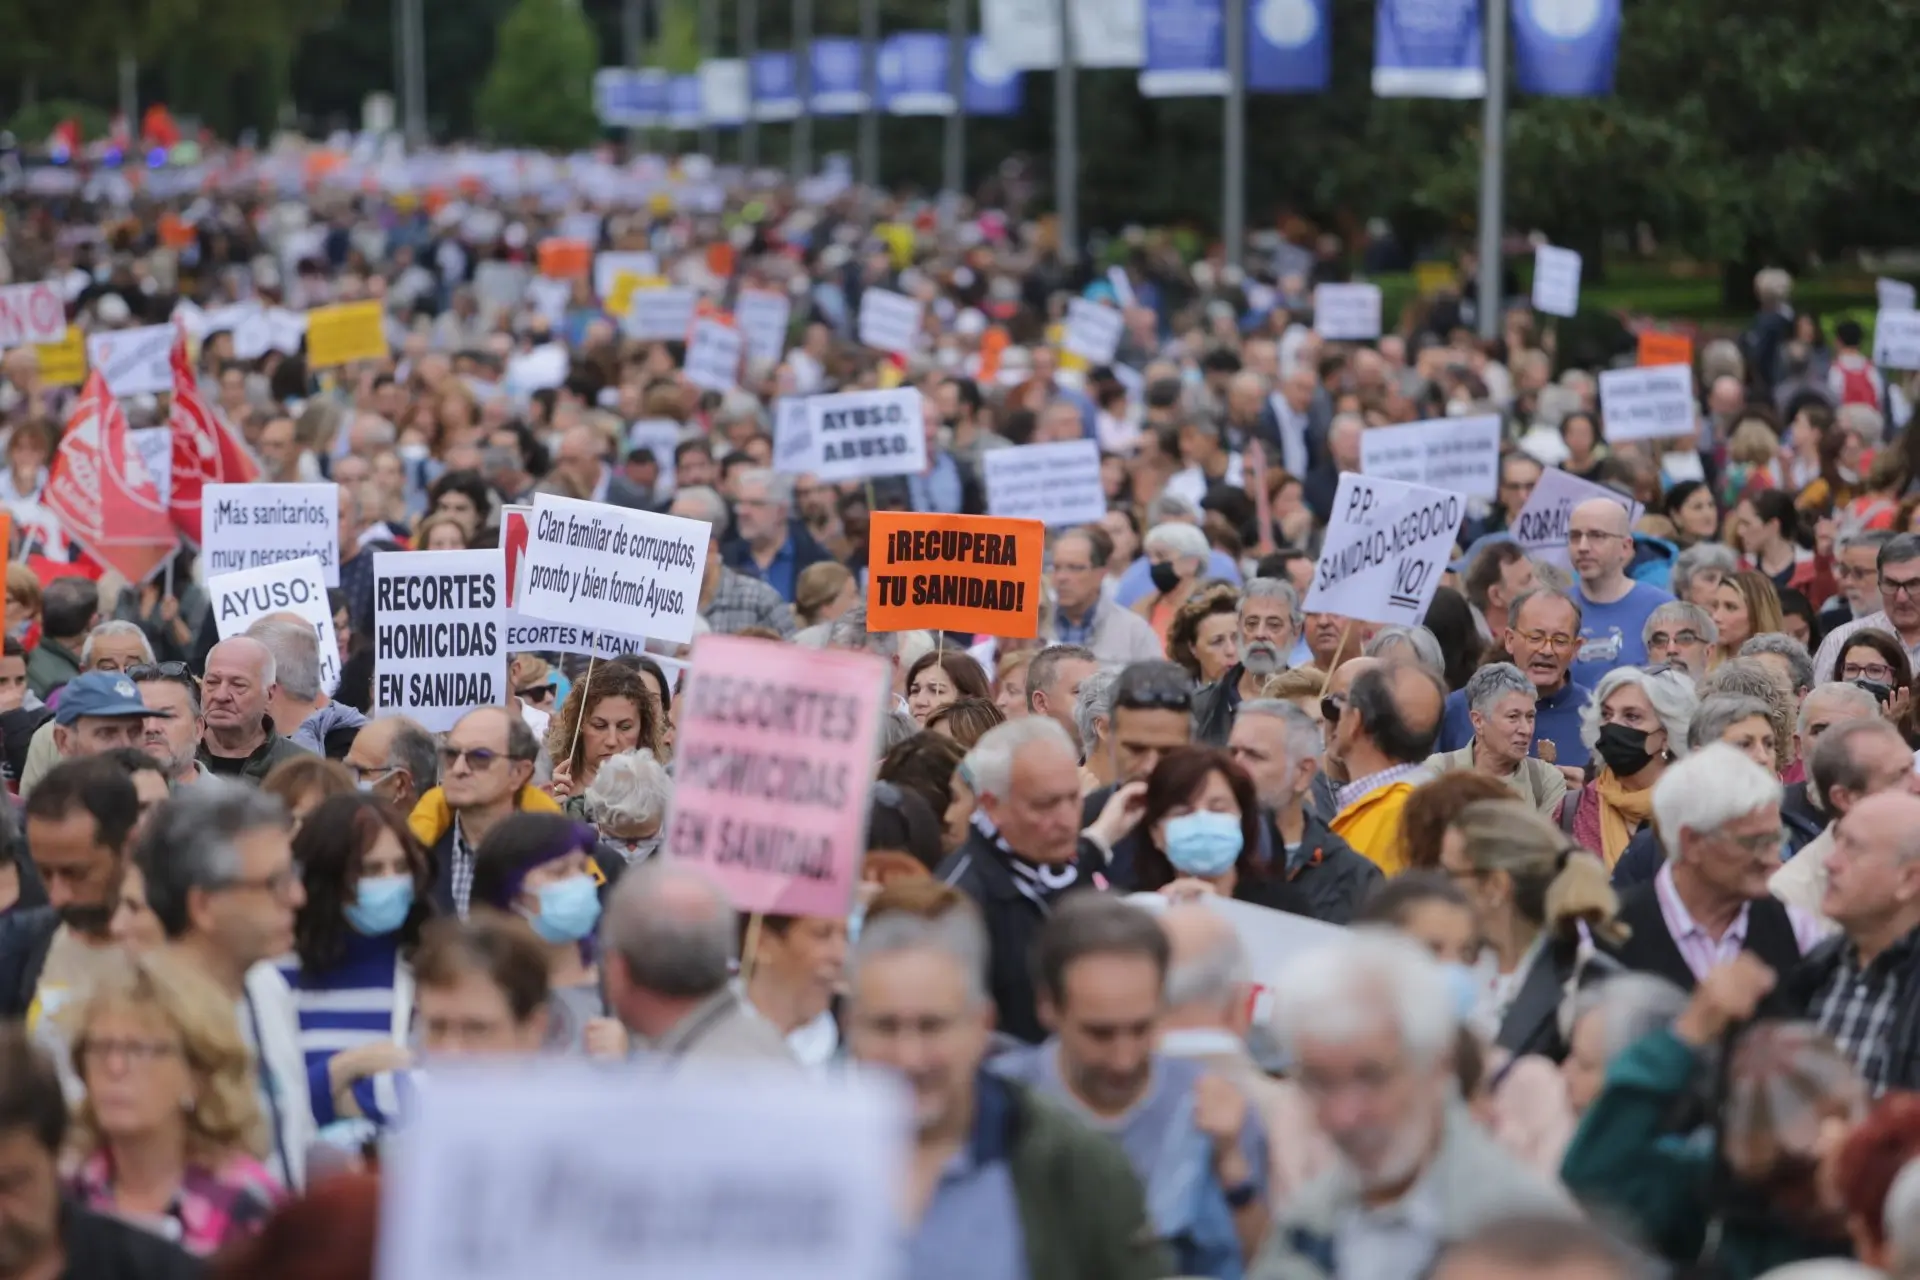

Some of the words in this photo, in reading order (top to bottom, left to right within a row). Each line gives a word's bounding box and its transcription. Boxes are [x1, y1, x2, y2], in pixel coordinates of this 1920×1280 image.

[213, 499, 248, 533] ¡Más
[253, 498, 329, 528] sanitarios,
[212, 550, 245, 571] muy
[537, 509, 564, 544] Clan
[566, 514, 613, 552] familiar
[612, 523, 628, 555] de
[629, 534, 696, 575] corrupptos,
[887, 530, 1017, 566] ¡RECUPERA
[221, 578, 319, 620] AYUSO:
[378, 573, 496, 611] RECORTES
[529, 563, 570, 595] pronto
[569, 572, 581, 603] y
[580, 566, 608, 600] bien
[609, 570, 645, 607] formó
[644, 578, 685, 618] Ayuso.
[877, 575, 908, 607] TU
[912, 574, 1026, 613] SANIDAD!
[379, 621, 497, 659] HOMICIDAS
[505, 626, 577, 645] ECORTES
[379, 673, 404, 707] EN
[409, 672, 496, 707] SANIDAD.
[690, 675, 861, 743] RECORTES
[681, 744, 852, 811] HOMICIDAS
[671, 810, 711, 859] EN
